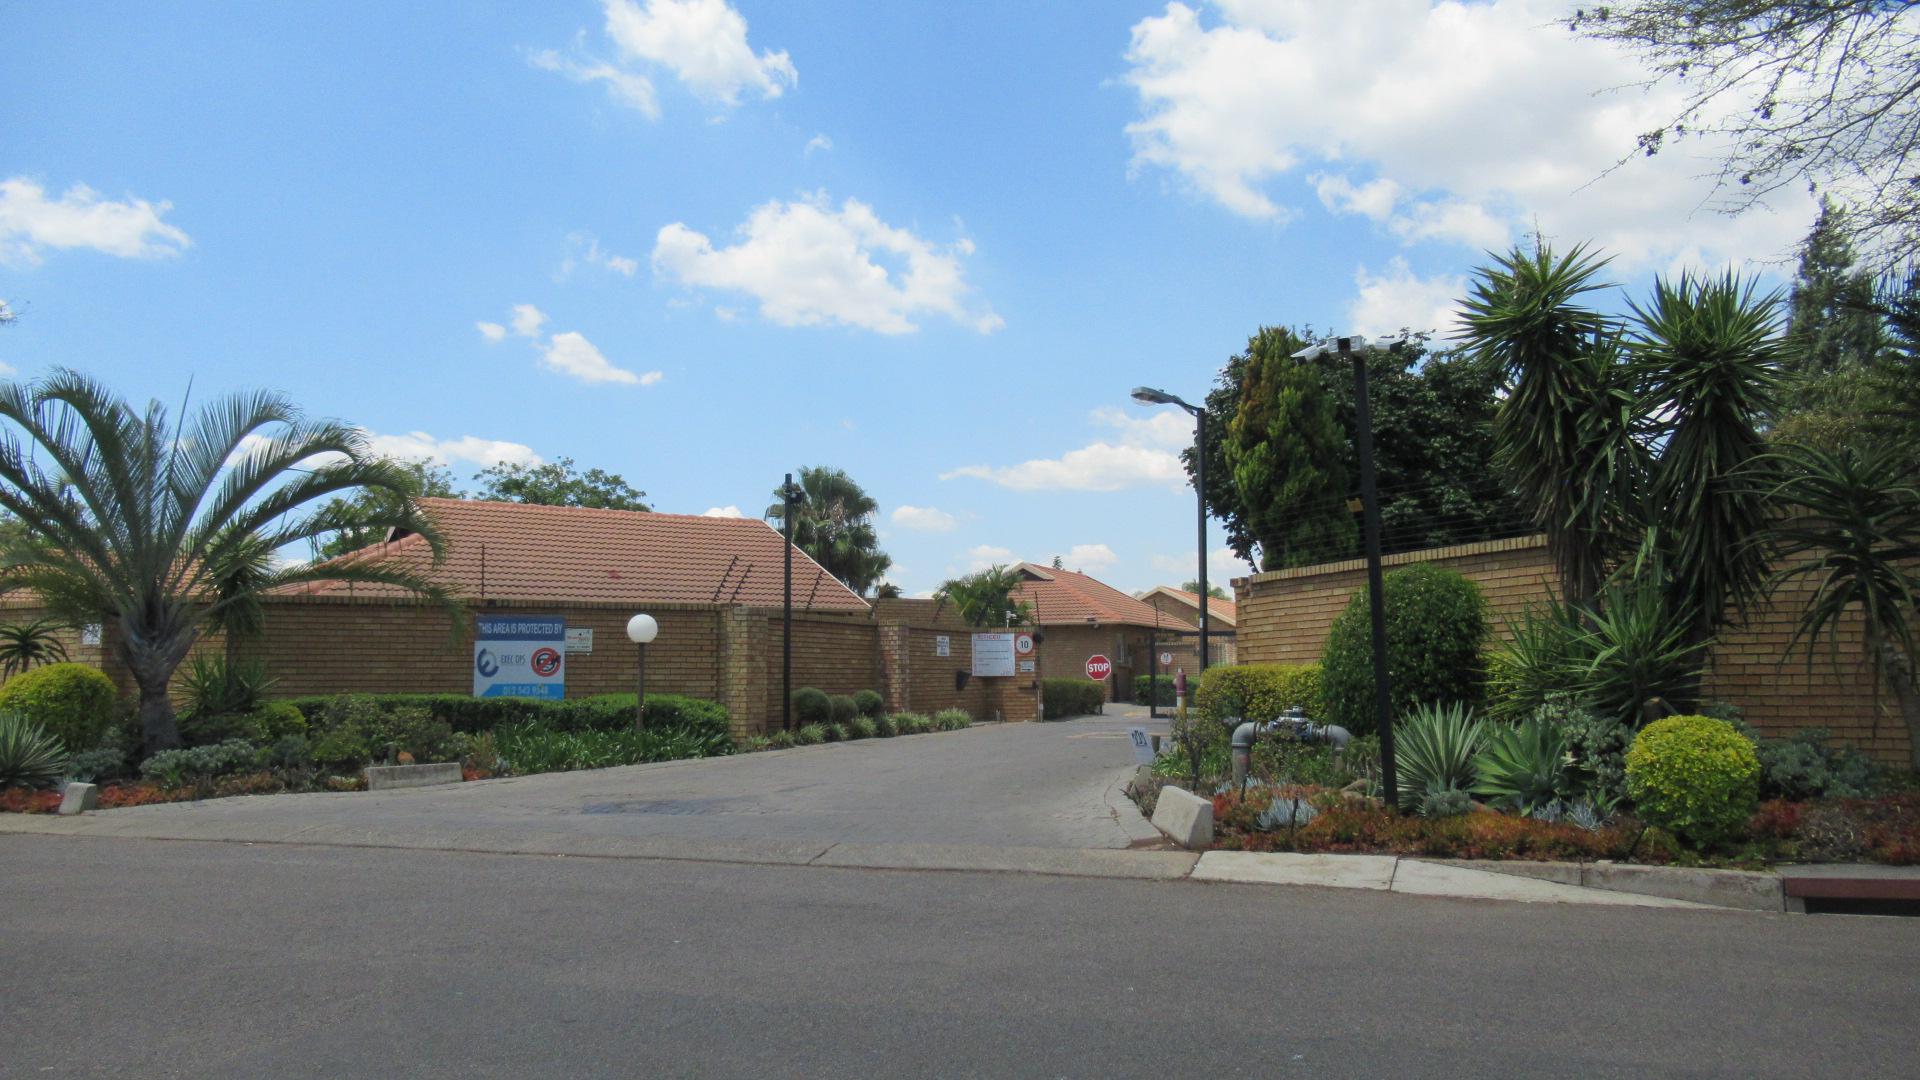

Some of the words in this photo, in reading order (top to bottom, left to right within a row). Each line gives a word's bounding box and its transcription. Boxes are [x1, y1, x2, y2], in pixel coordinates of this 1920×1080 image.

[478, 623, 492, 633] THIS
[493, 623, 509, 633] AREA
[510, 623, 516, 634] IS
[518, 623, 553, 634] PROTECTED
[554, 623, 563, 634] BY
[1020, 641, 1029, 649] 10
[1088, 663, 1109, 672] STOP
